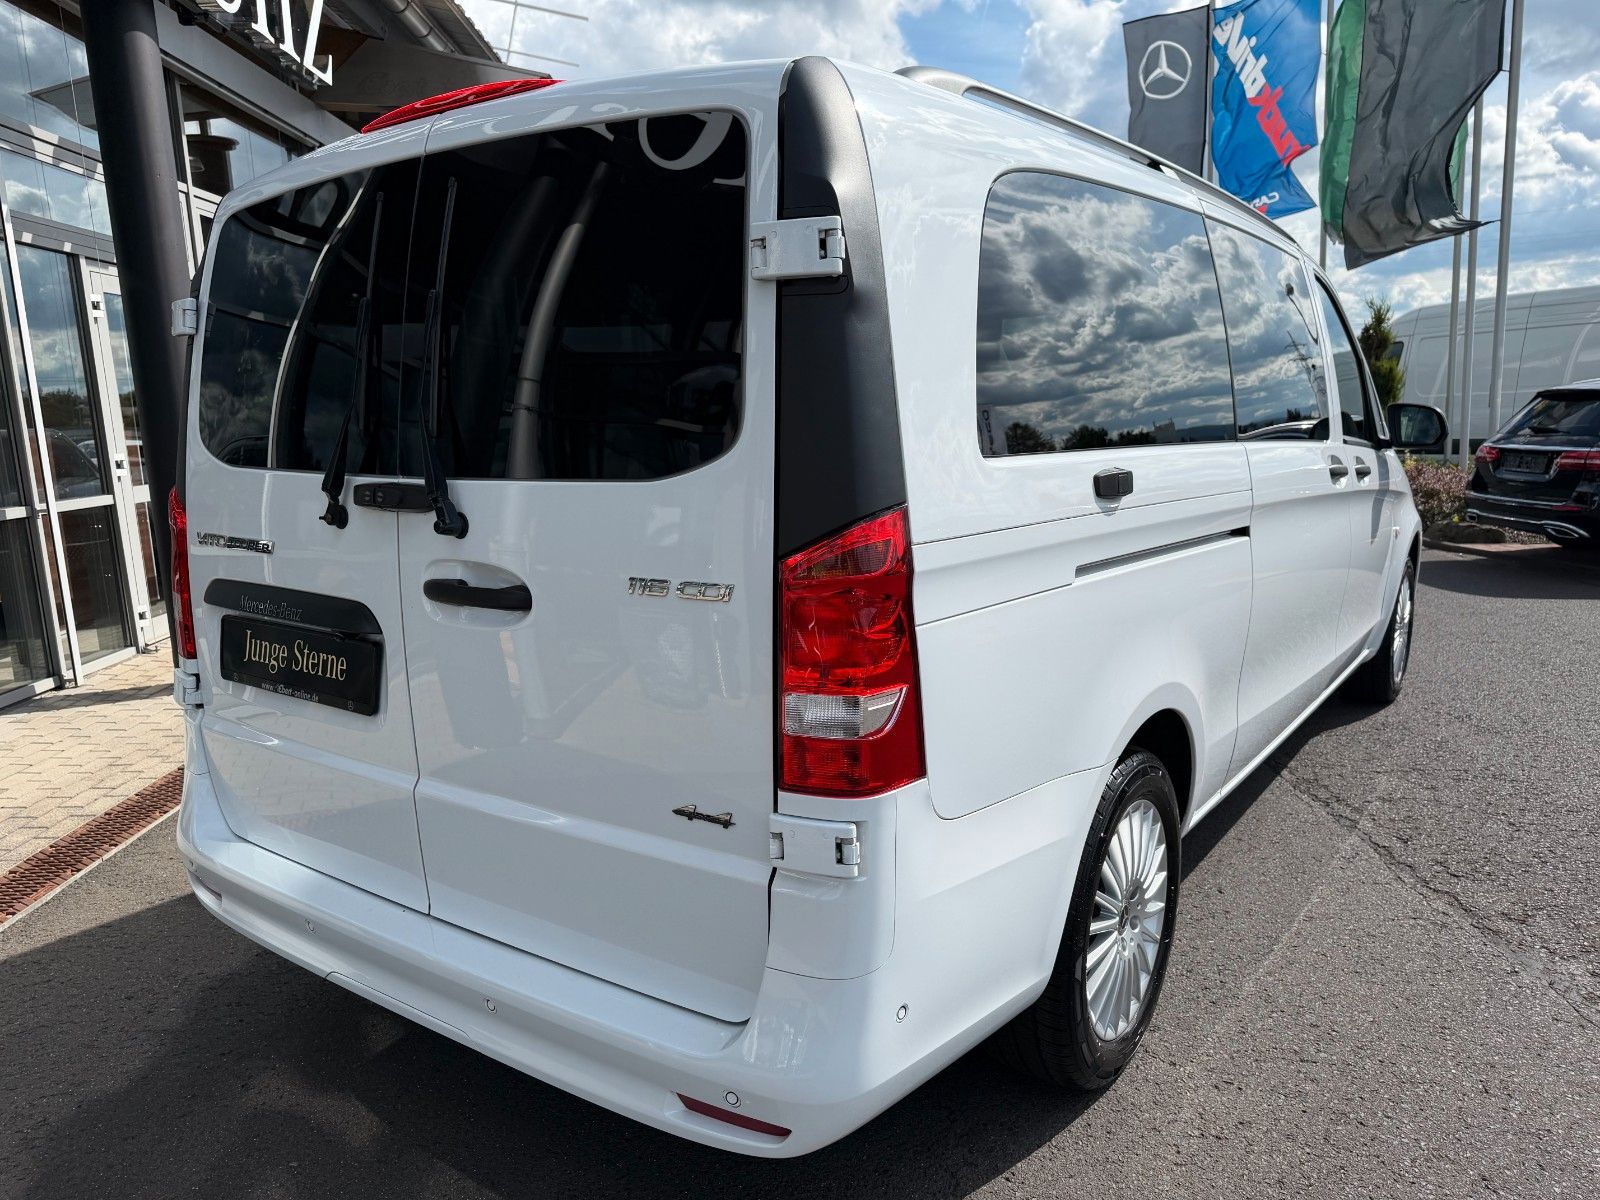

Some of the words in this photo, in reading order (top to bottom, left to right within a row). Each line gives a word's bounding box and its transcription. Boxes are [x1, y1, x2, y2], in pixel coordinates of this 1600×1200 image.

[675, 581, 735, 603] CDI
[240, 595, 303, 620] Mercedes-Benz
[243, 629, 288, 674] Junge
[292, 639, 347, 681] Sterne
